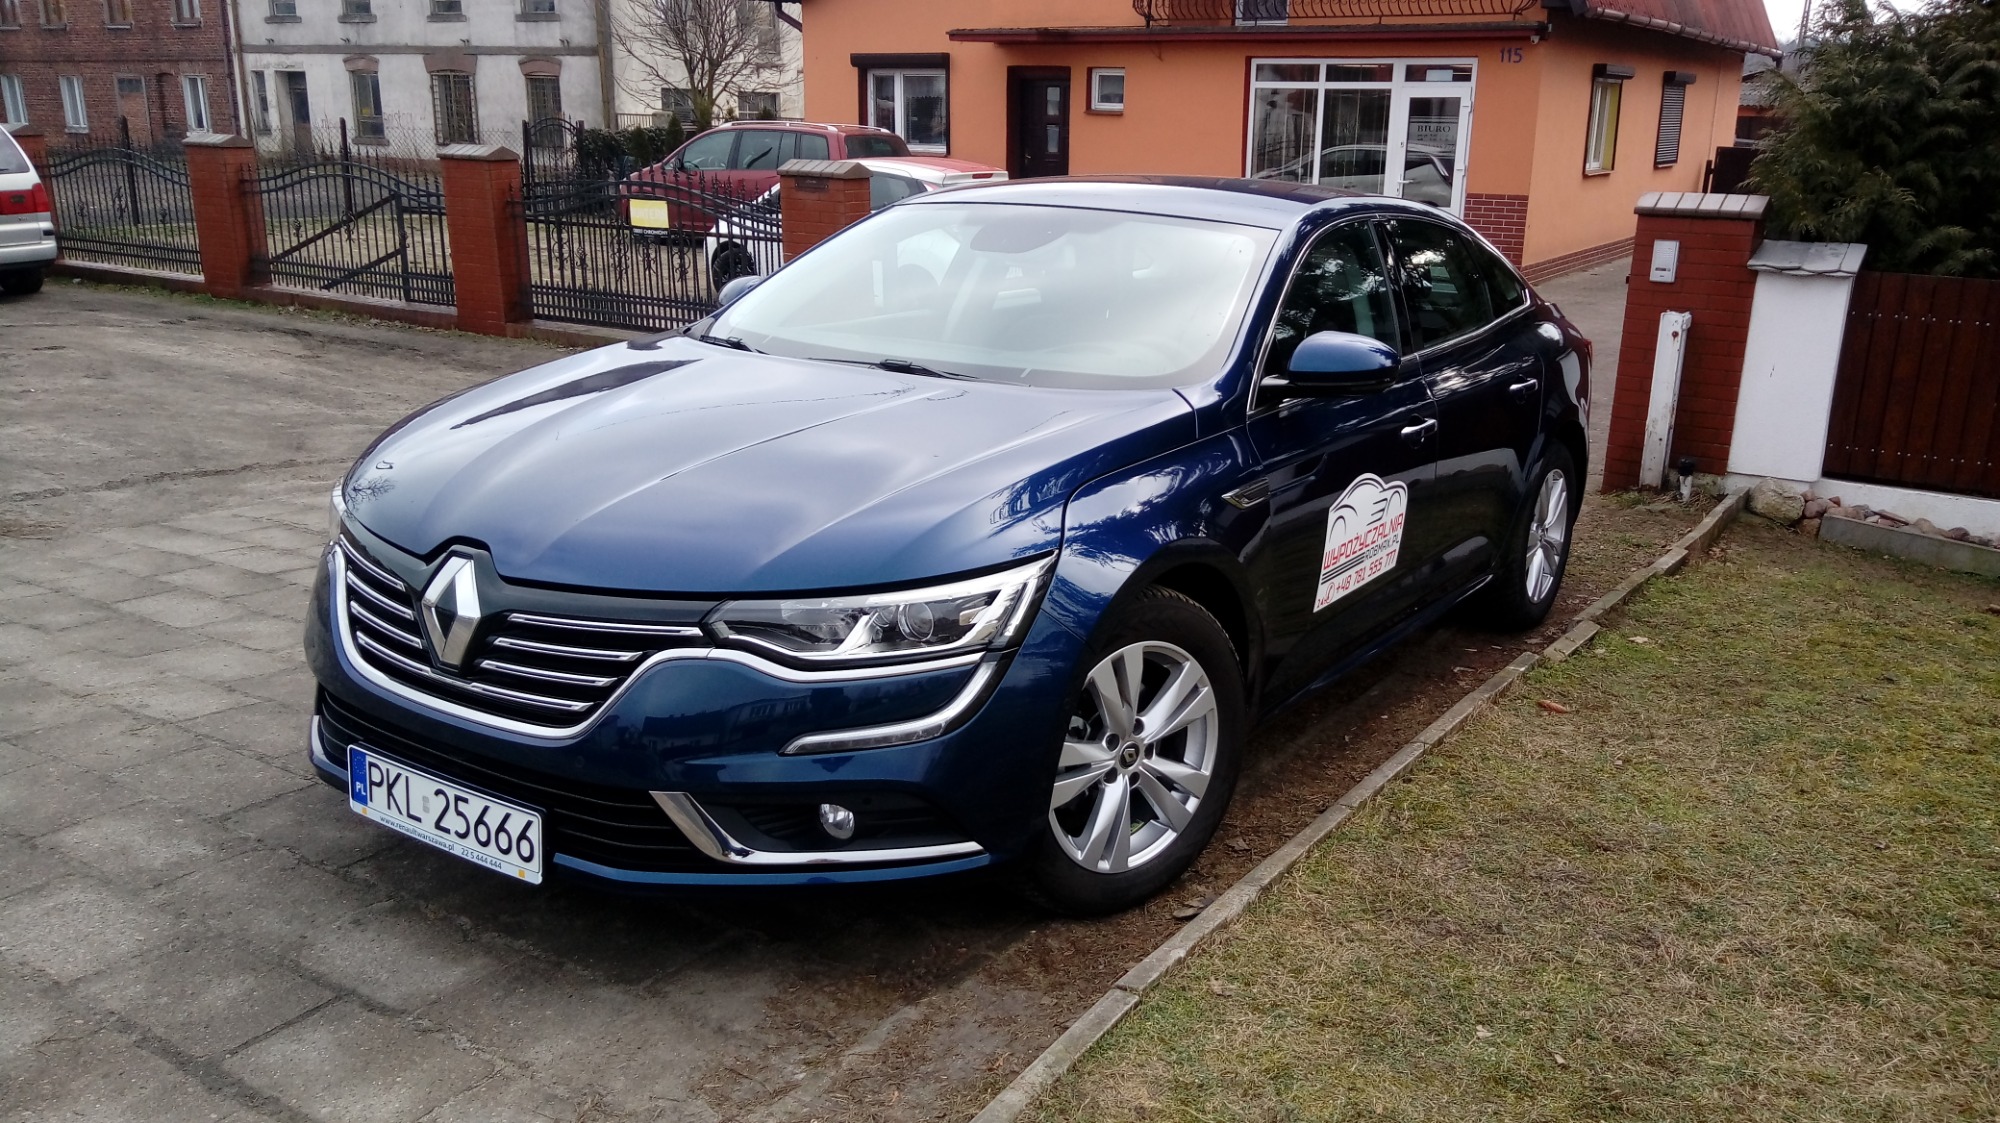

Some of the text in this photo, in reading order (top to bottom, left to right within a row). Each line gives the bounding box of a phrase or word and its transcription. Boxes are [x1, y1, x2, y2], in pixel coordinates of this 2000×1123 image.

[1500, 47, 1523, 63] 115
[1417, 125, 1451, 133] BIURO
[1323, 512, 1404, 570] WYPOŻYCZALNIA
[1336, 574, 1352, 592] +48
[1368, 556, 1384, 577] 555
[1385, 549, 1396, 567] 777
[355, 781, 367, 795] PL
[368, 761, 535, 863] PKL 25666
[380, 816, 455, 852] www.renaultwarszawa.pl
[460, 847, 469, 857] 22
[475, 855, 488, 864] 444
[489, 860, 502, 870] 444
